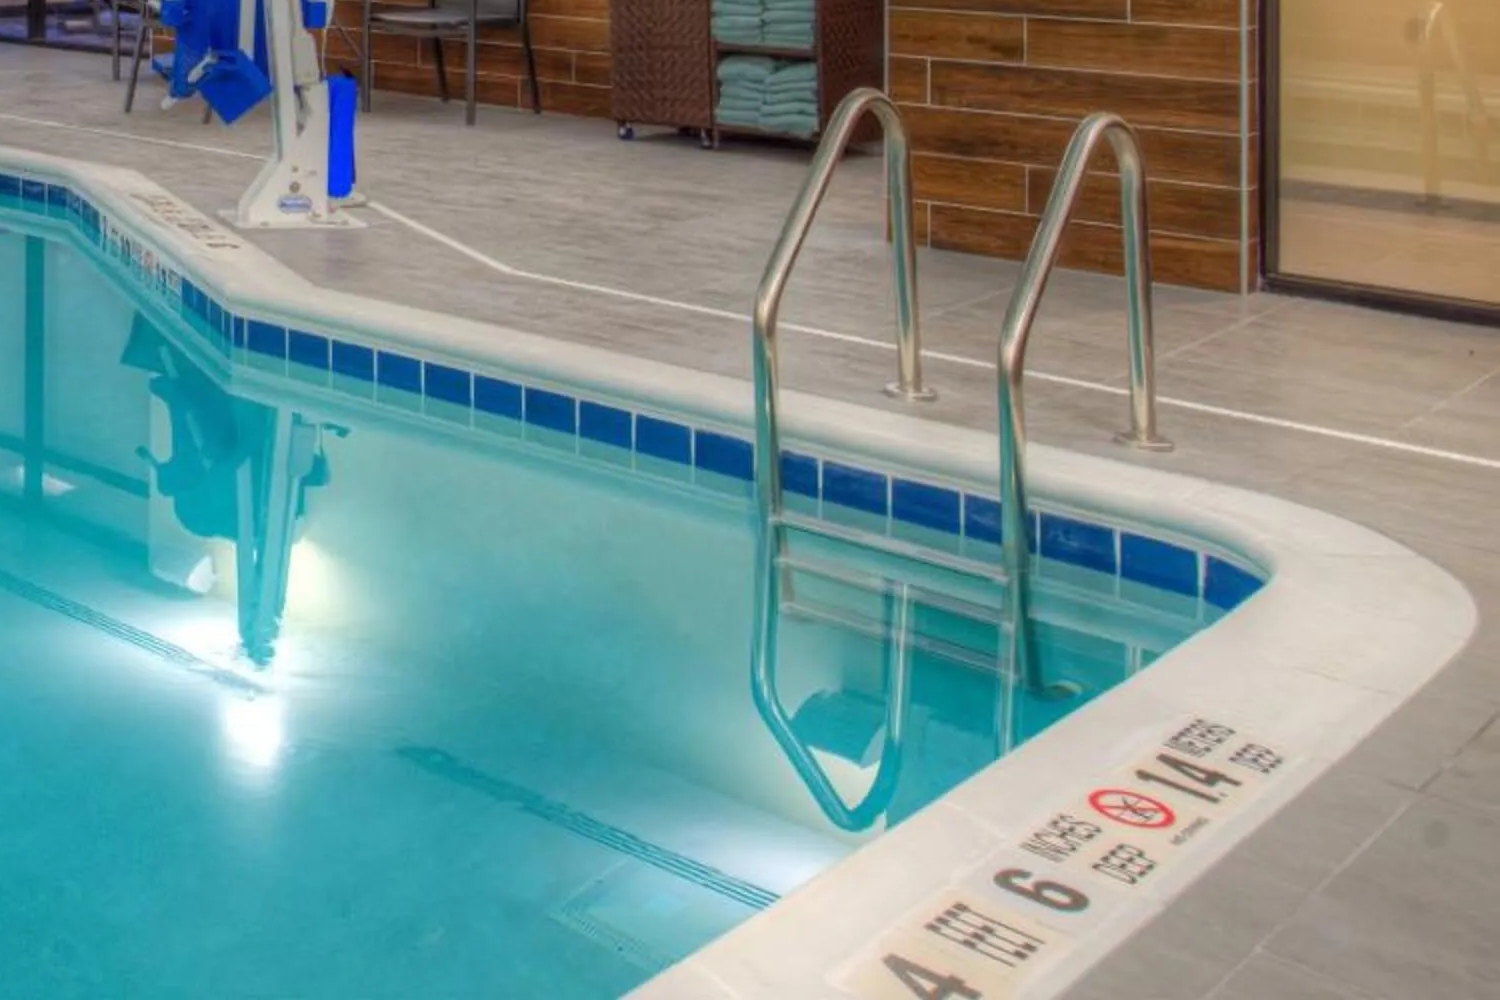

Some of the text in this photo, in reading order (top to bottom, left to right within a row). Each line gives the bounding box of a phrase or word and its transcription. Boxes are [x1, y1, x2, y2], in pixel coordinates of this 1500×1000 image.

[882, 813, 1103, 1000] 4 FEET 6 INCHES
[1091, 843, 1157, 885] DEEP
